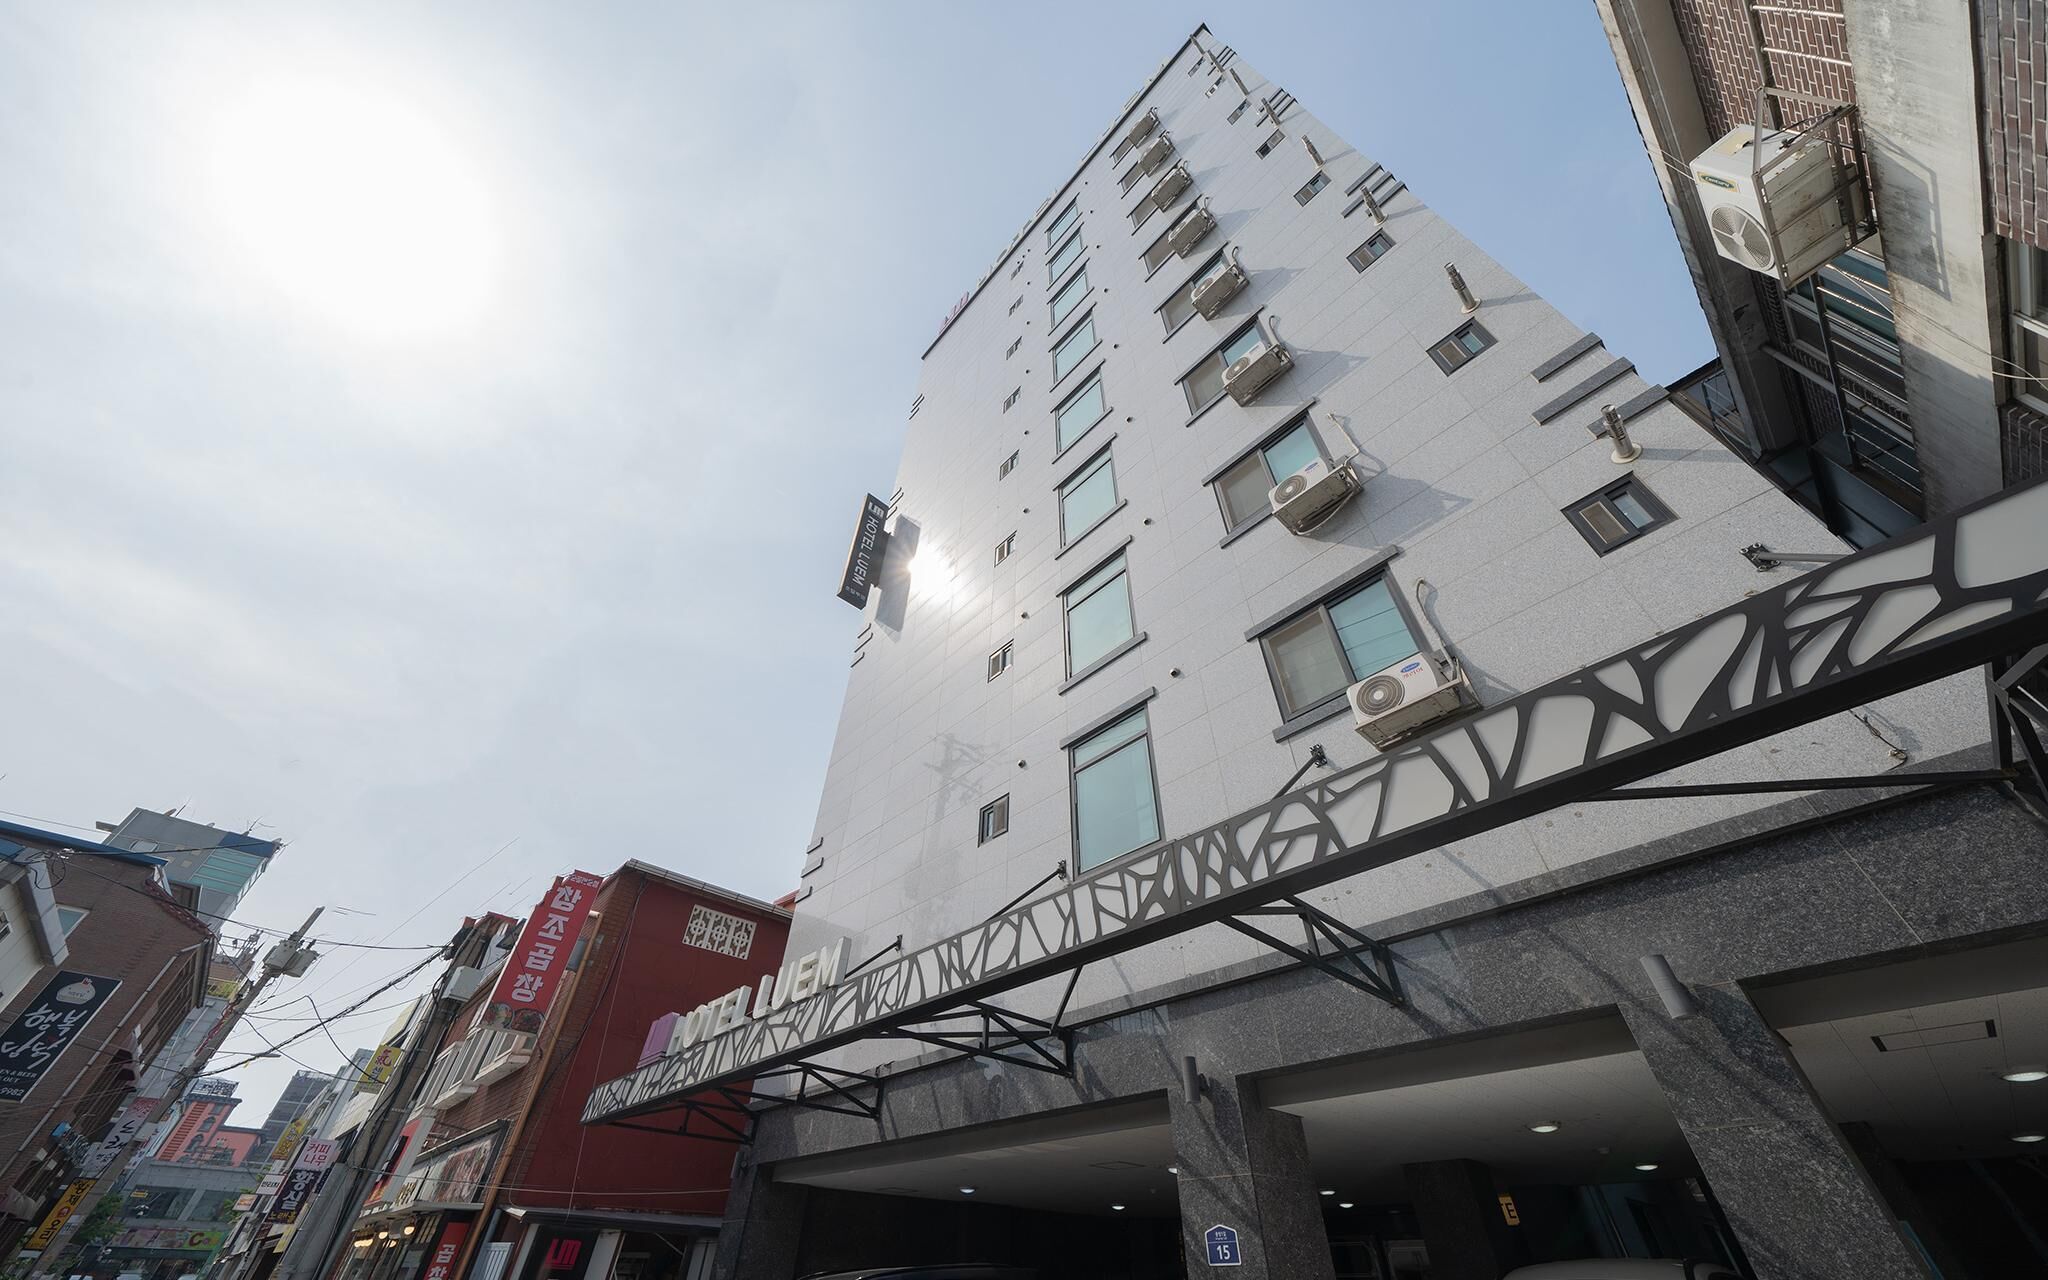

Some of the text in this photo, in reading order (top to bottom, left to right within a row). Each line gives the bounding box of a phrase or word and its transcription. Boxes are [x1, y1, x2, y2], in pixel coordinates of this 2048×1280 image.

[861, 516, 880, 551] HOTEL
[852, 552, 871, 587] LUEM
[666, 984, 752, 1056] HOTEL
[753, 936, 852, 1019] LUEM
[25, 1003, 88, 1037] 행복
[304, 1154, 328, 1167] 나무
[307, 1143, 331, 1155] 커피
[282, 1170, 315, 1210] 황실
[1216, 1244, 1231, 1260] 15
